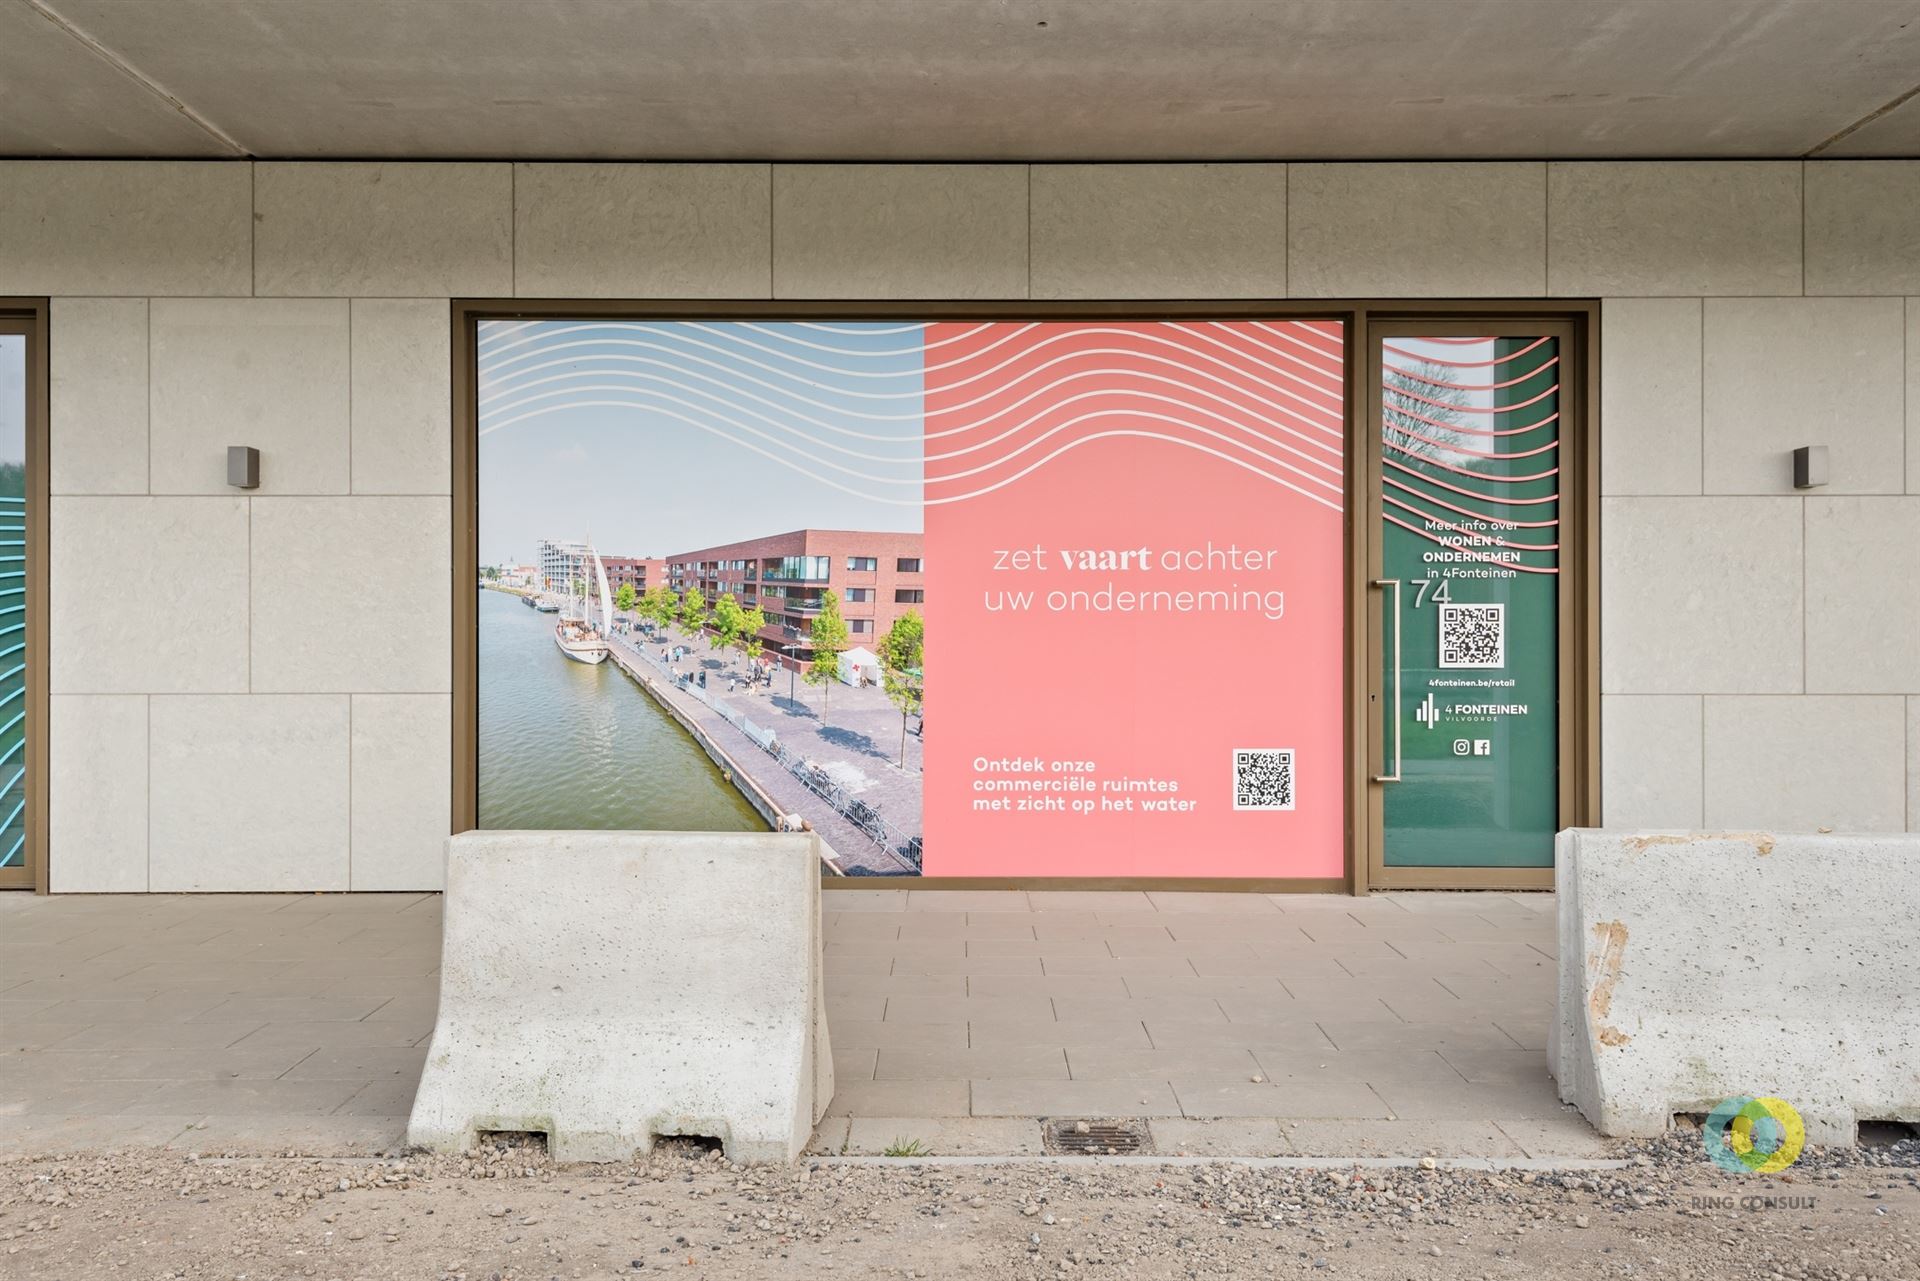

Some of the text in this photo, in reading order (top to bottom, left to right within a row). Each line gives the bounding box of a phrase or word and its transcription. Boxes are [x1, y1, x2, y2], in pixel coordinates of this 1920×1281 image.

[1425, 519, 1520, 531] Meer info over
[1438, 536, 1505, 546] WONEN &
[992, 541, 1278, 571] zet vaart achter
[1423, 552, 1521, 562] ONDERNEMEN
[1427, 568, 1517, 578] in 4Fonteinen
[984, 581, 1285, 619] uw onderneming
[1410, 579, 1452, 608] 74
[1429, 679, 1515, 687] 4fonteinen.be/retail
[1445, 705, 1528, 715] 4 FONTEINEN
[973, 757, 1095, 772] Ontdek onze
[973, 776, 1178, 792] commerciële ruimtes
[973, 796, 1196, 815] met zicht op het water
